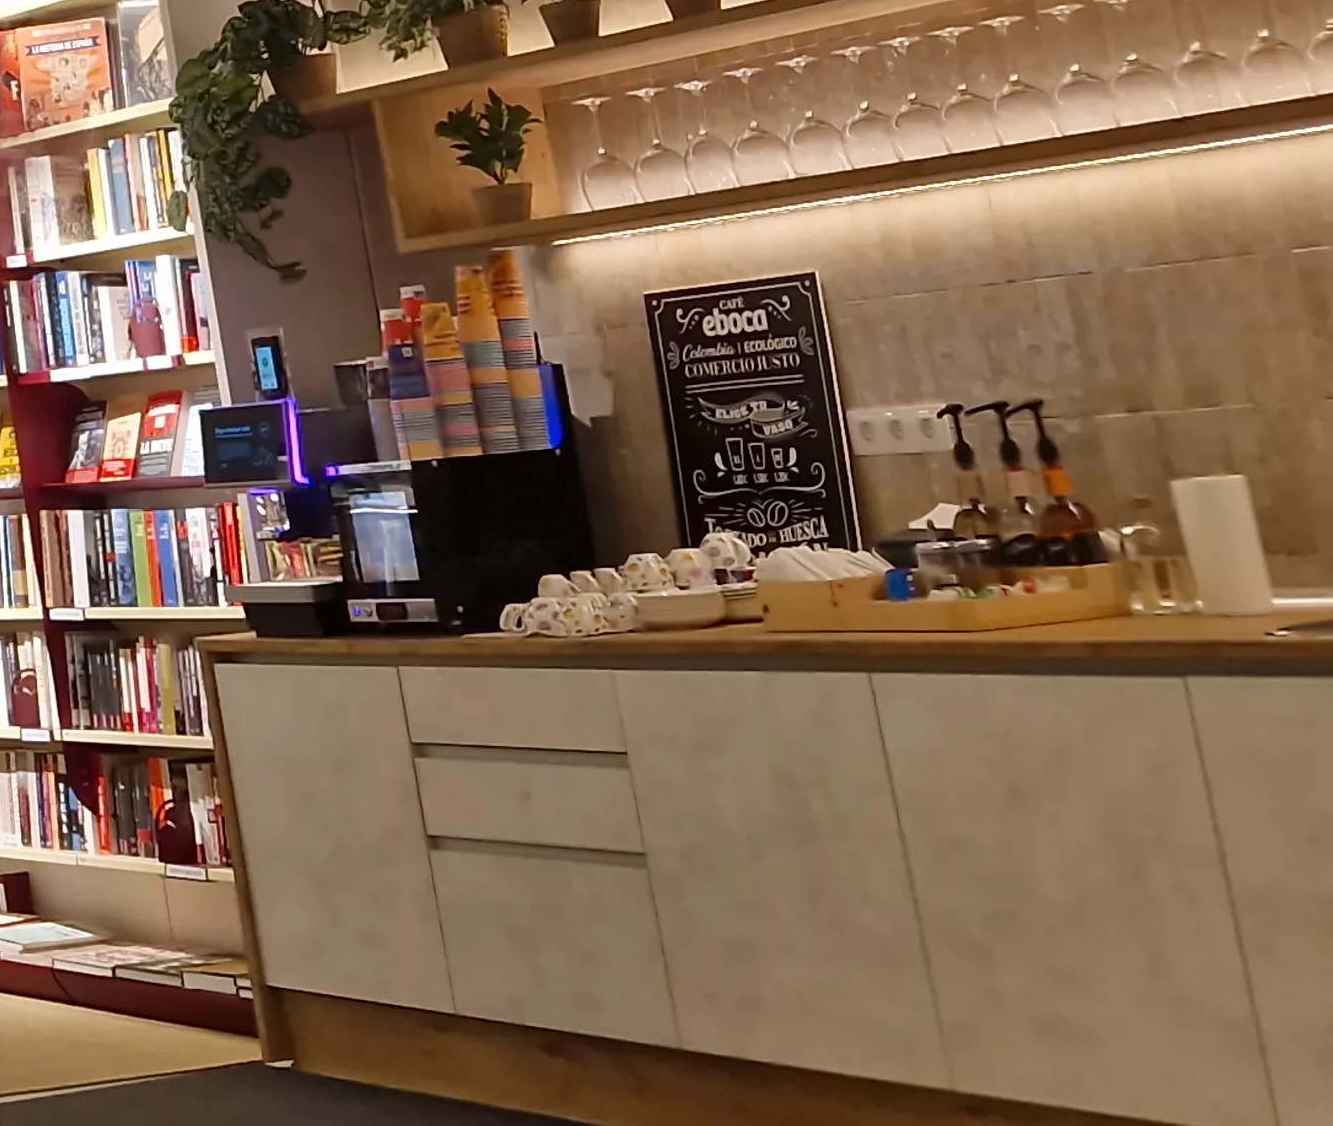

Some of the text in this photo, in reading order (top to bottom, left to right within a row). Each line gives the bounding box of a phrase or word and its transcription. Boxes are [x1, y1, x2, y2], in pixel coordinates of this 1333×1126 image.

[702, 307, 769, 336] eboca
[682, 334, 798, 362] Colombia ECOLÓGICO
[684, 353, 801, 378] COMERCIO JUSTO
[763, 419, 793, 436] VASO
[778, 515, 830, 544] HUESCA
